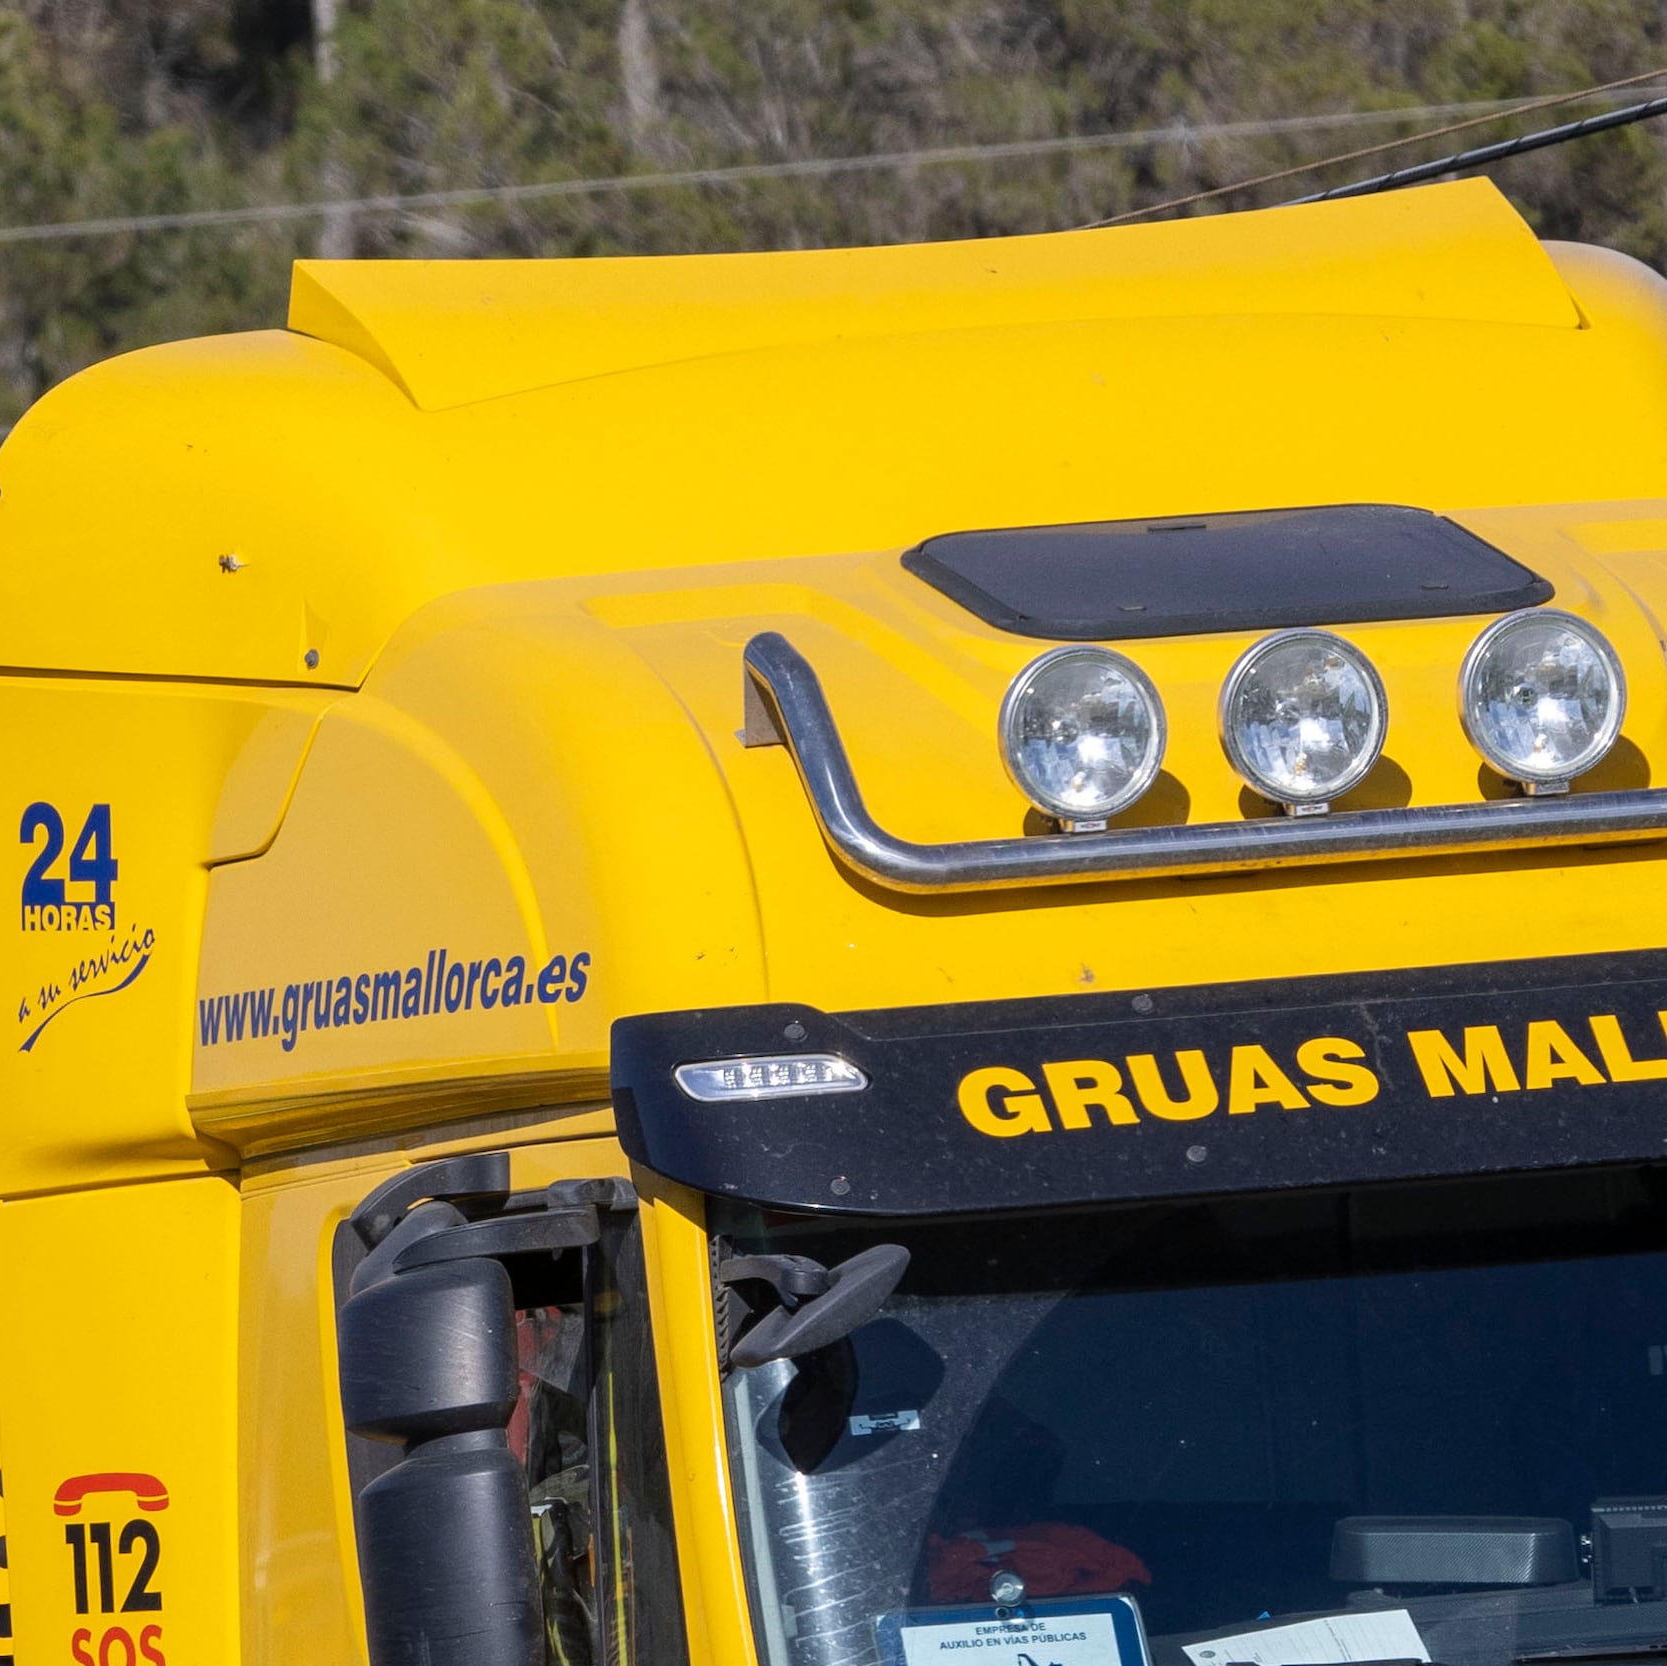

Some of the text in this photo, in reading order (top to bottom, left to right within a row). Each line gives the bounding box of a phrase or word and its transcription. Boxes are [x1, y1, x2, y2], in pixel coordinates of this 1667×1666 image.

[19, 801, 118, 904] 24
[23, 903, 115, 931] HORAS
[38, 984, 61, 1010] su
[69, 923, 156, 992] servicio
[198, 948, 592, 1053] www.gruasmallorca.es
[956, 1009, 1667, 1138] GRUAS MAL
[65, 1518, 163, 1616] 112
[939, 1631, 1087, 1650] AUXILIO EN VÍAS PÚBLICAS
[975, 1622, 1046, 1635] EMPRESA DE
